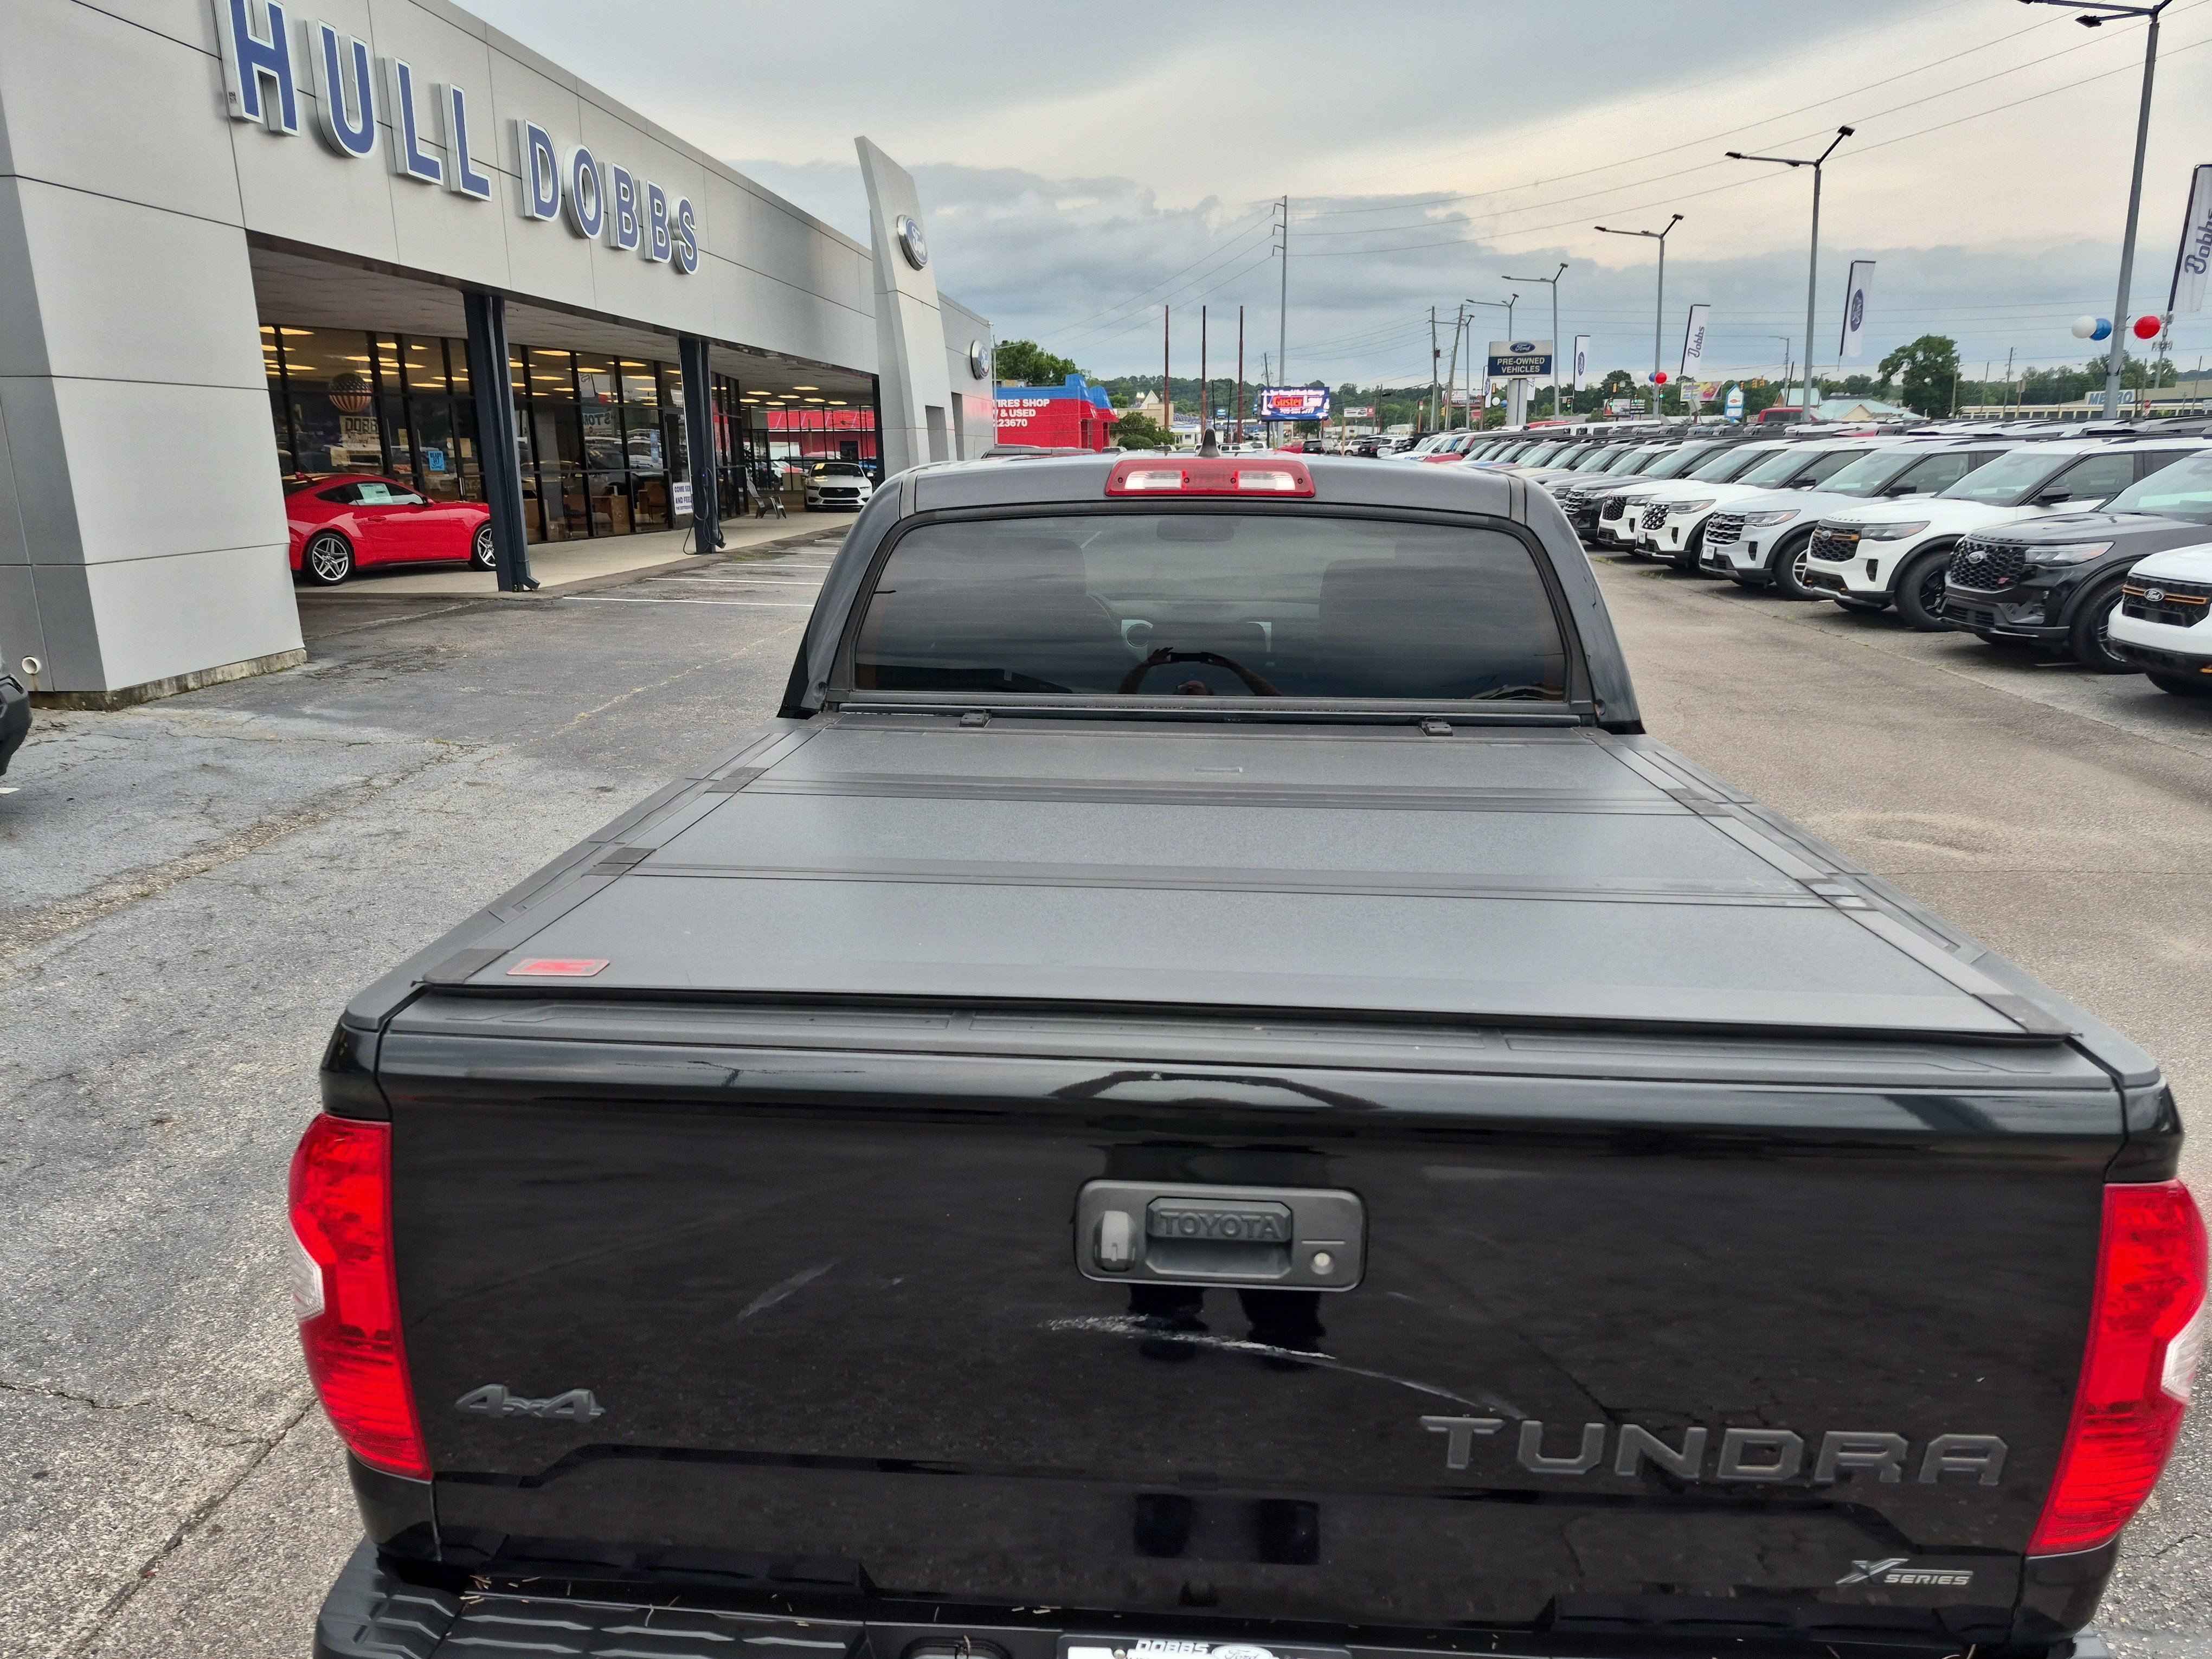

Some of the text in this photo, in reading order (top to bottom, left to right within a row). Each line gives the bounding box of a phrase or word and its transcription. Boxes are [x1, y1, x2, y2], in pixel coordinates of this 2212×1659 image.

[228, 0, 699, 275] HULL DOBBS
[1687, 326, 1705, 358] Dobbs
[1497, 357, 1545, 365] PRE-OWNED
[1023, 398, 1050, 407] SHOP
[1273, 395, 1323, 407] Guster Law
[2088, 391, 2133, 405] MERO
[1000, 409, 1008, 417] &
[1009, 409, 1036, 417] USED
[1160, 1211, 1283, 1239] TOYOTA
[1419, 1414, 2008, 1487] TUNDRA
[1883, 1573, 1971, 1586] SERIES
[1135, 1639, 1210, 1655] DOBBS
